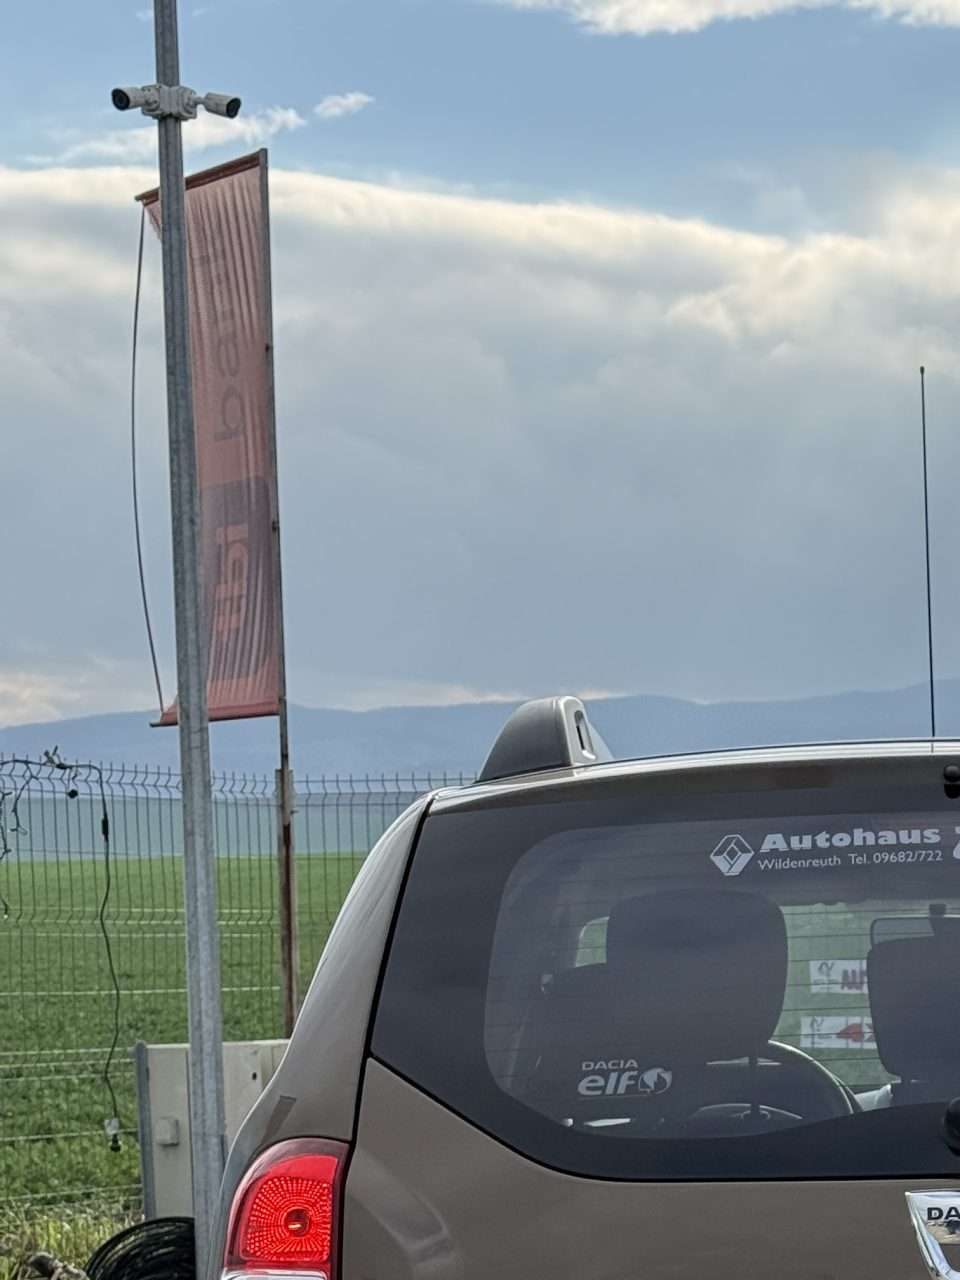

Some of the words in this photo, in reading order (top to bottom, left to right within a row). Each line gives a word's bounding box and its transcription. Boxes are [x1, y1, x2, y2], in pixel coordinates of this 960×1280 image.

[760, 828, 942, 853] Autohaus
[757, 855, 842, 871] Wildenreuth
[847, 853, 870, 865] Tel.
[872, 850, 943, 864] 09682/722
[581, 1059, 639, 1072] DACIA
[577, 1070, 639, 1096] elf
